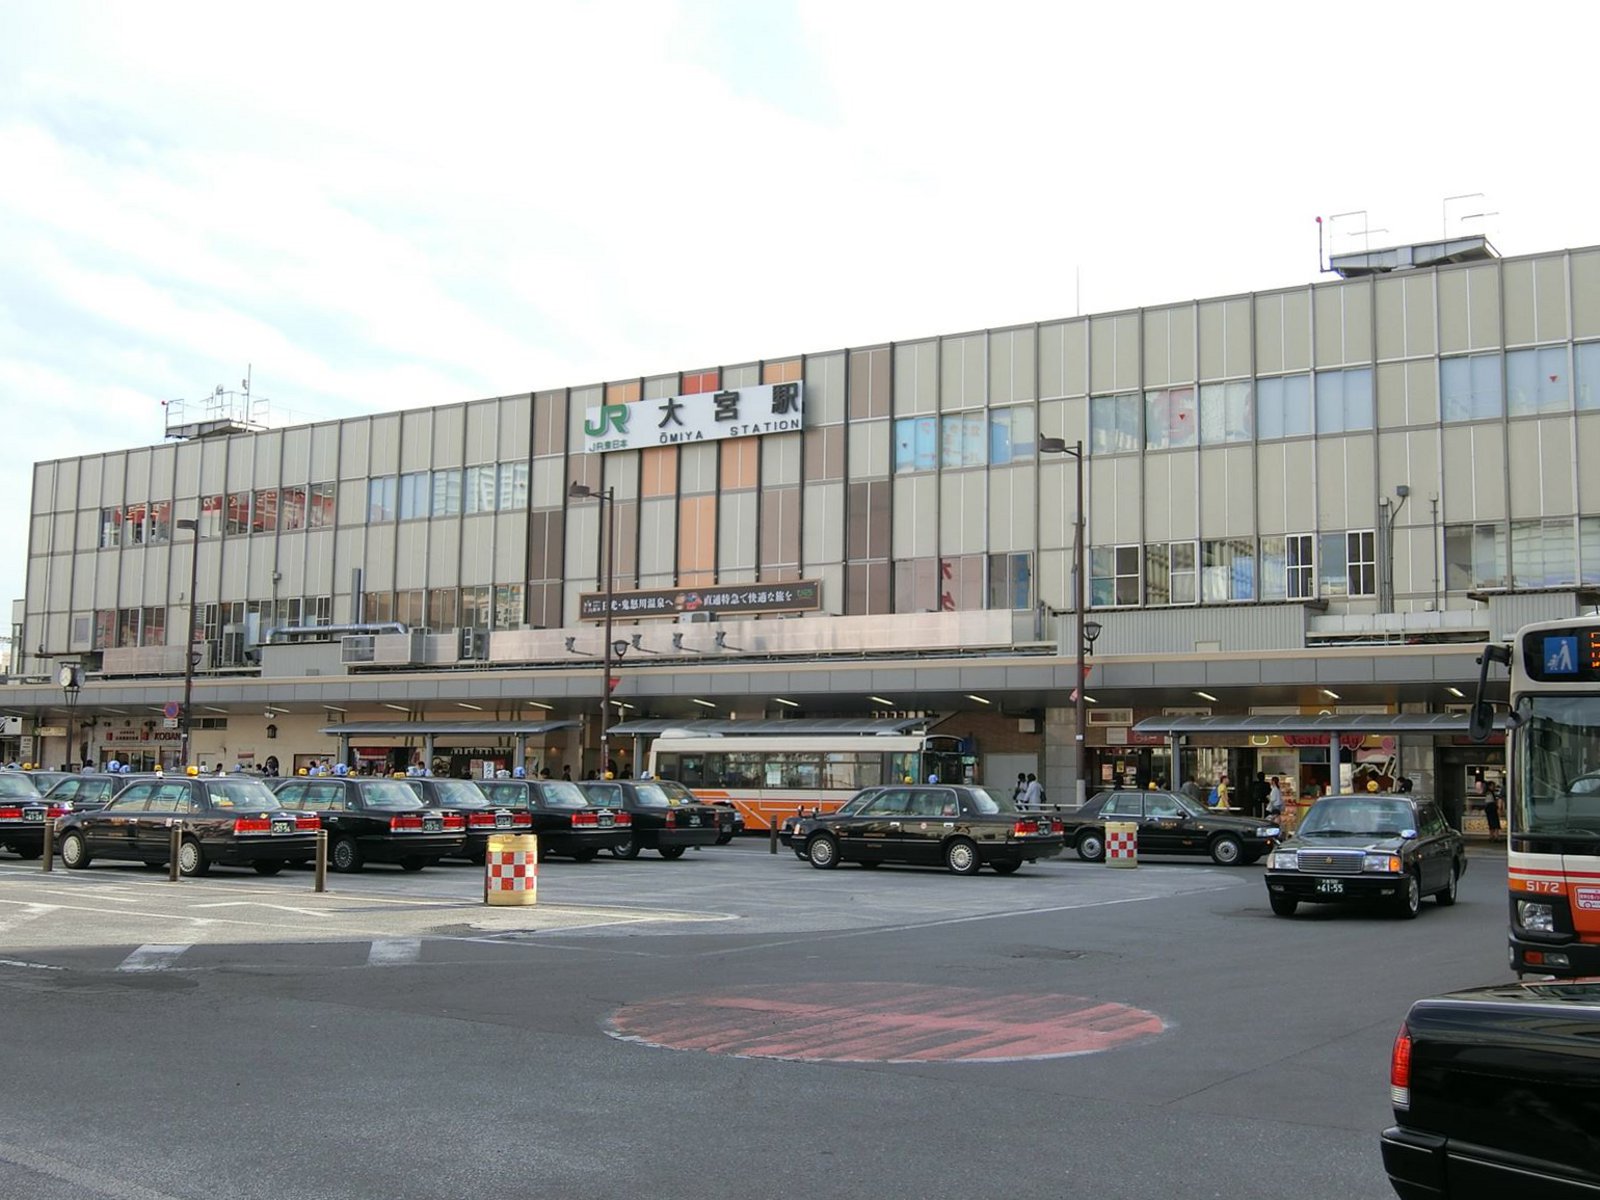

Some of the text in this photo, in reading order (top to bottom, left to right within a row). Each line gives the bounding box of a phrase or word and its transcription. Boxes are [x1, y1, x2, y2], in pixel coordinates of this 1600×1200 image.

[658, 382, 799, 428] 大宮駅
[584, 404, 628, 435] JR
[730, 419, 799, 436] STATION
[589, 439, 628, 452] JR東日本
[1526, 881, 1559, 893] 5172
